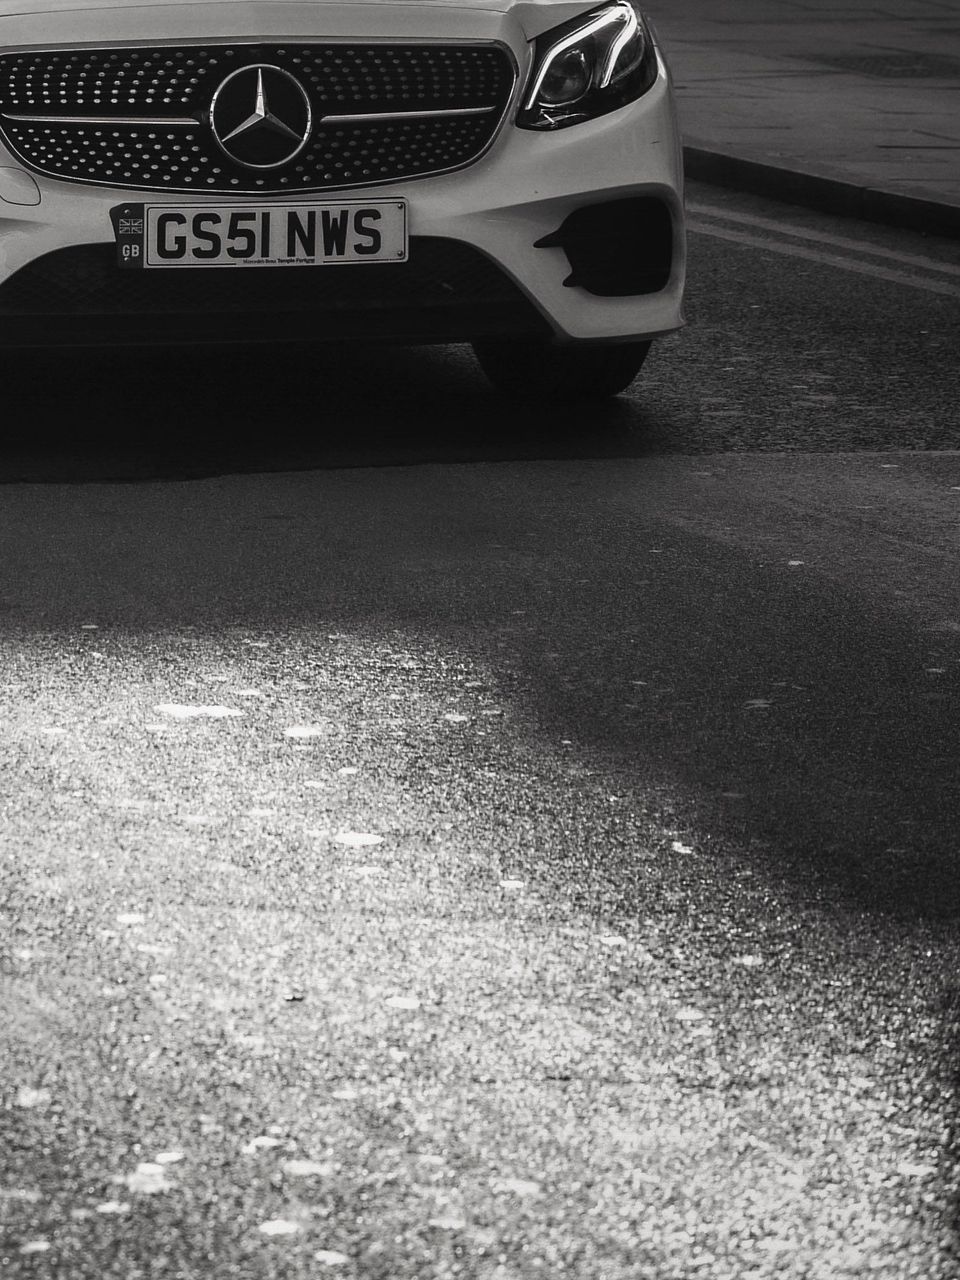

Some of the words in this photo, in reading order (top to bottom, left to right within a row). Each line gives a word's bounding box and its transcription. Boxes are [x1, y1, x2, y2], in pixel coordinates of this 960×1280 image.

[156, 211, 270, 259] GS51
[287, 208, 382, 258] NWS
[122, 244, 140, 257] GB
